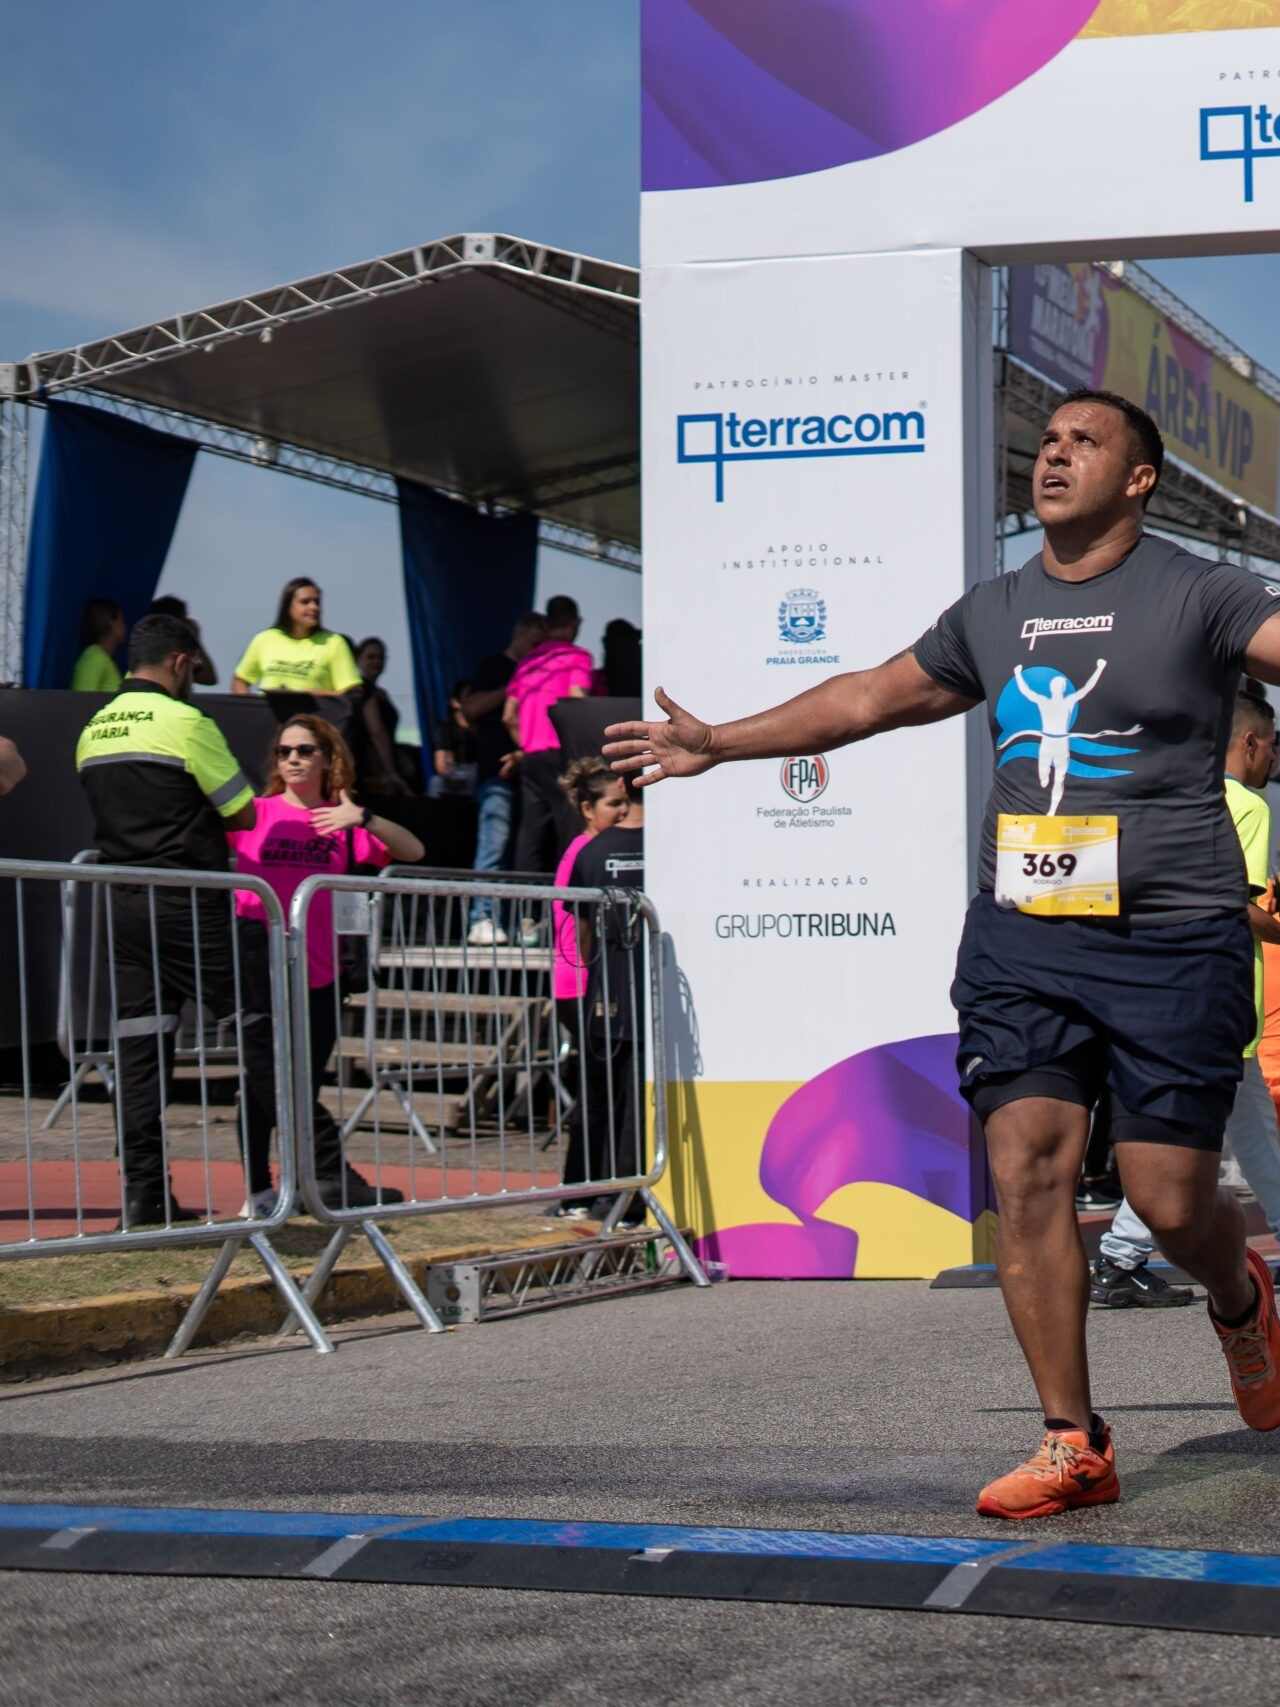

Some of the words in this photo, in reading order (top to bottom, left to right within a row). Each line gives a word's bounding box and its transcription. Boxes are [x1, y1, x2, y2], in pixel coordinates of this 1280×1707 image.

[694, 376, 818, 391] PATROCÍNIO
[833, 371, 910, 384] MASTER
[1144, 321, 1211, 459] ÁREA
[1215, 390, 1254, 480] VIP
[725, 411, 925, 448] terracom
[767, 543, 828, 554] APOIO
[722, 555, 884, 570] INSTITUCIONAL
[1038, 615, 1114, 631] terracom
[766, 657, 796, 665] PRAIA
[798, 655, 840, 664] GRANDE
[90, 711, 154, 725] GURANÇA
[789, 759, 820, 794] FPA
[756, 807, 810, 818] Federação
[812, 806, 852, 816] Paulista
[774, 820, 787, 828] de
[788, 818, 835, 828] Atletismo
[1022, 853, 1077, 877] 369
[742, 875, 868, 888] REALIZAÇÃO
